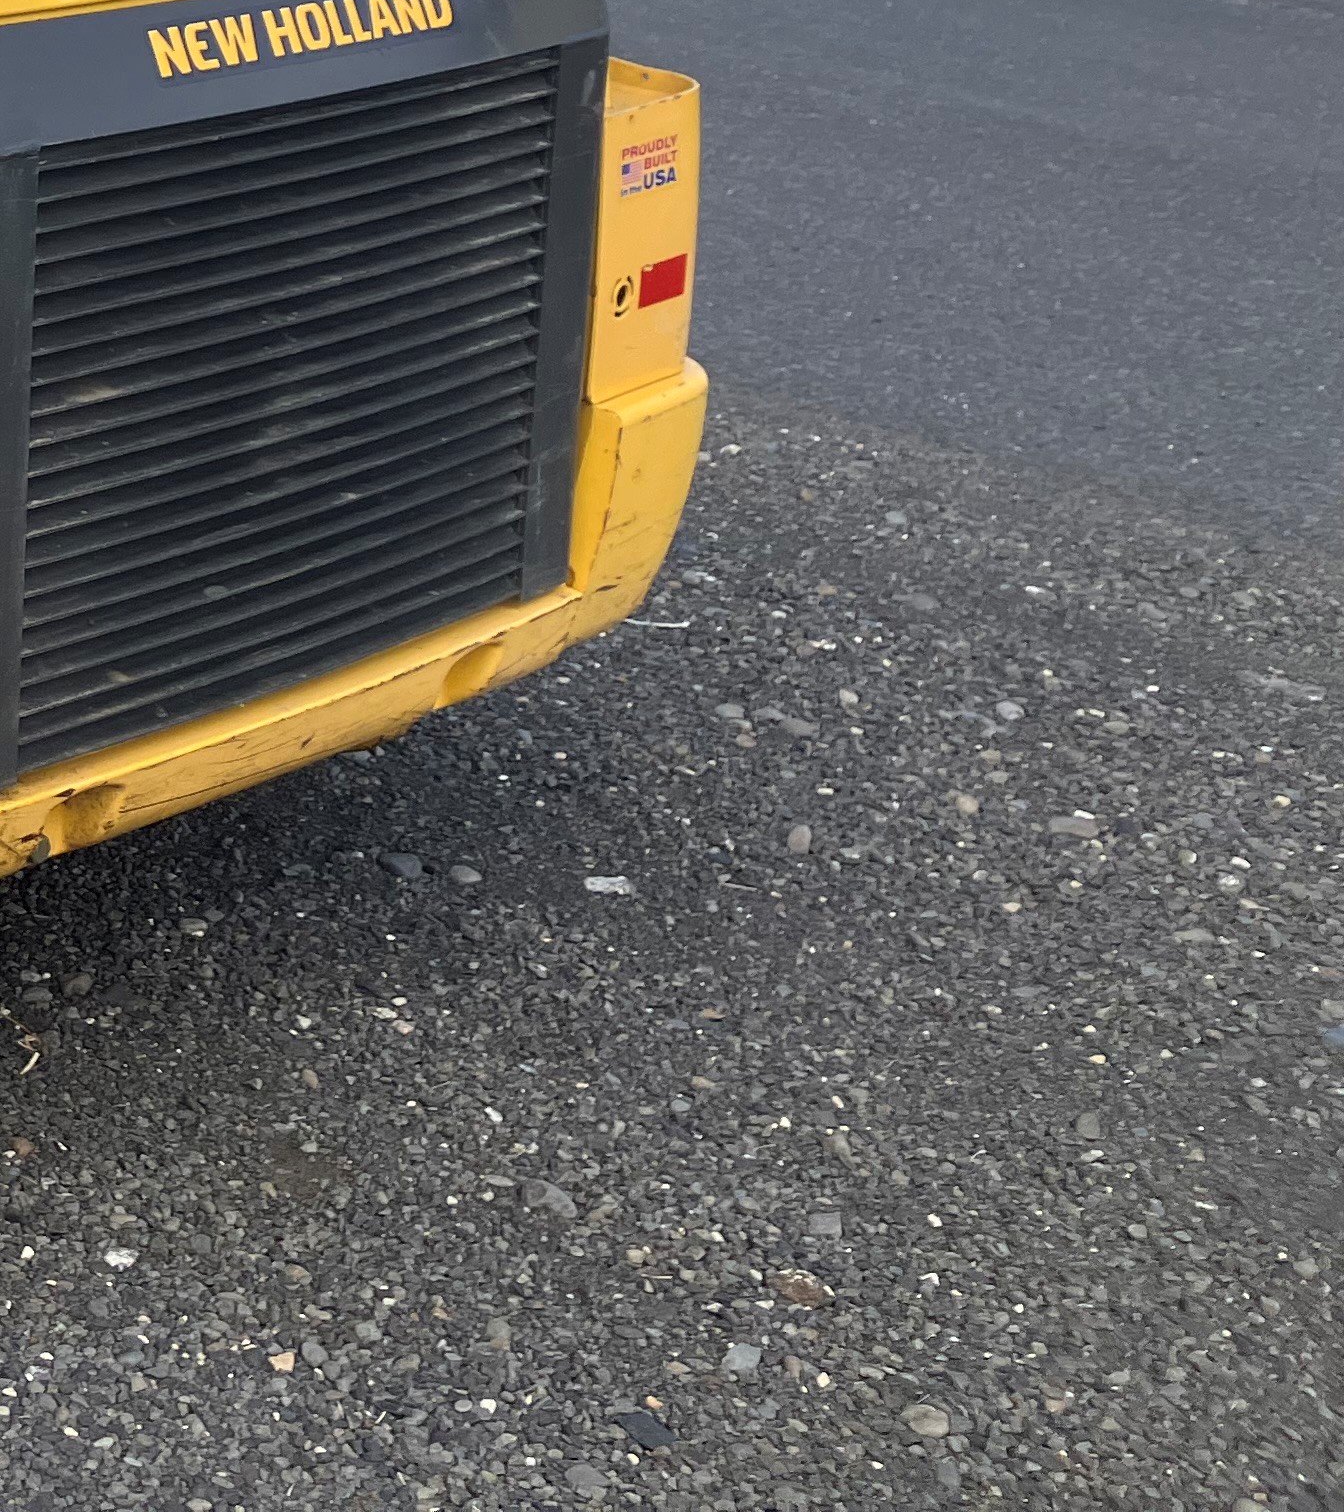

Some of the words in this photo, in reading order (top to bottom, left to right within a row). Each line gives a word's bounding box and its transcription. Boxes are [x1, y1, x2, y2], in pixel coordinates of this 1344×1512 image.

[147, 13, 259, 78] NEW
[622, 134, 678, 161] PROUDLY
[644, 150, 677, 170] BUILT
[644, 167, 677, 189] USA
